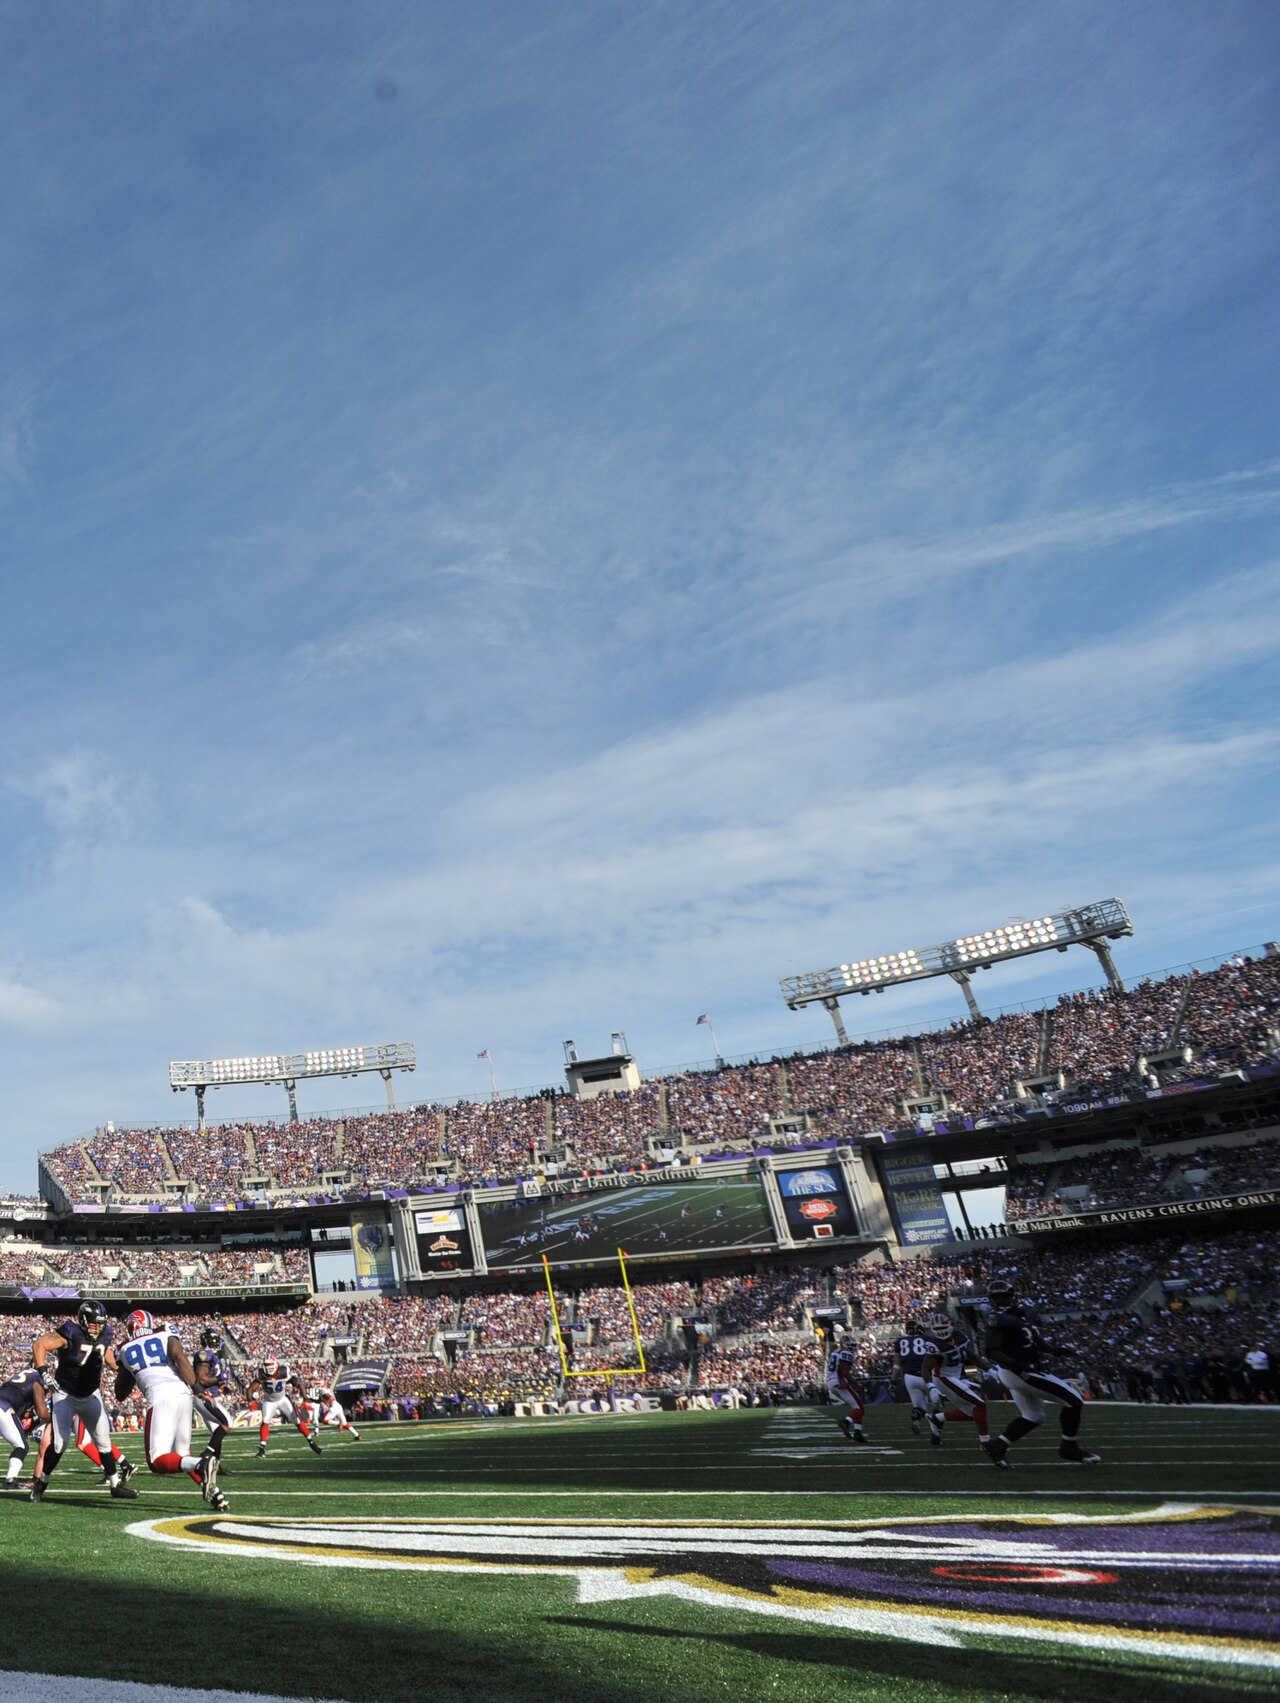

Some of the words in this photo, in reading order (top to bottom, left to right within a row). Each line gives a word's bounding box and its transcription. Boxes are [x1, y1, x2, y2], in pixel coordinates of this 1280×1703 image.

[1062, 1102, 1089, 1113] 1090
[1089, 1101, 1103, 1110] AM
[1107, 1094, 1131, 1105] WBAL
[545, 1179, 583, 1194] M&T
[588, 1172, 628, 1189] Bank
[632, 1167, 703, 1185] Stadium
[792, 1186, 813, 1195] THE
[814, 1183, 837, 1193] SUN
[893, 1188, 938, 1204] MORE
[1100, 1208, 1155, 1223] RAVENS
[1158, 1199, 1233, 1216] CHECKING
[1238, 1193, 1276, 1206] ONLY
[1030, 1221, 1053, 1232] M&T
[1054, 1218, 1083, 1229] Bank
[138, 1289, 171, 1298] RAVENS
[173, 1288, 218, 1298] CHECKING
[220, 1287, 242, 1296] ONLY
[245, 1287, 257, 1295] AT
[260, 1286, 278, 1295] M&T
[125, 1337, 168, 1375] 99
[899, 1338, 925, 1356] 88
